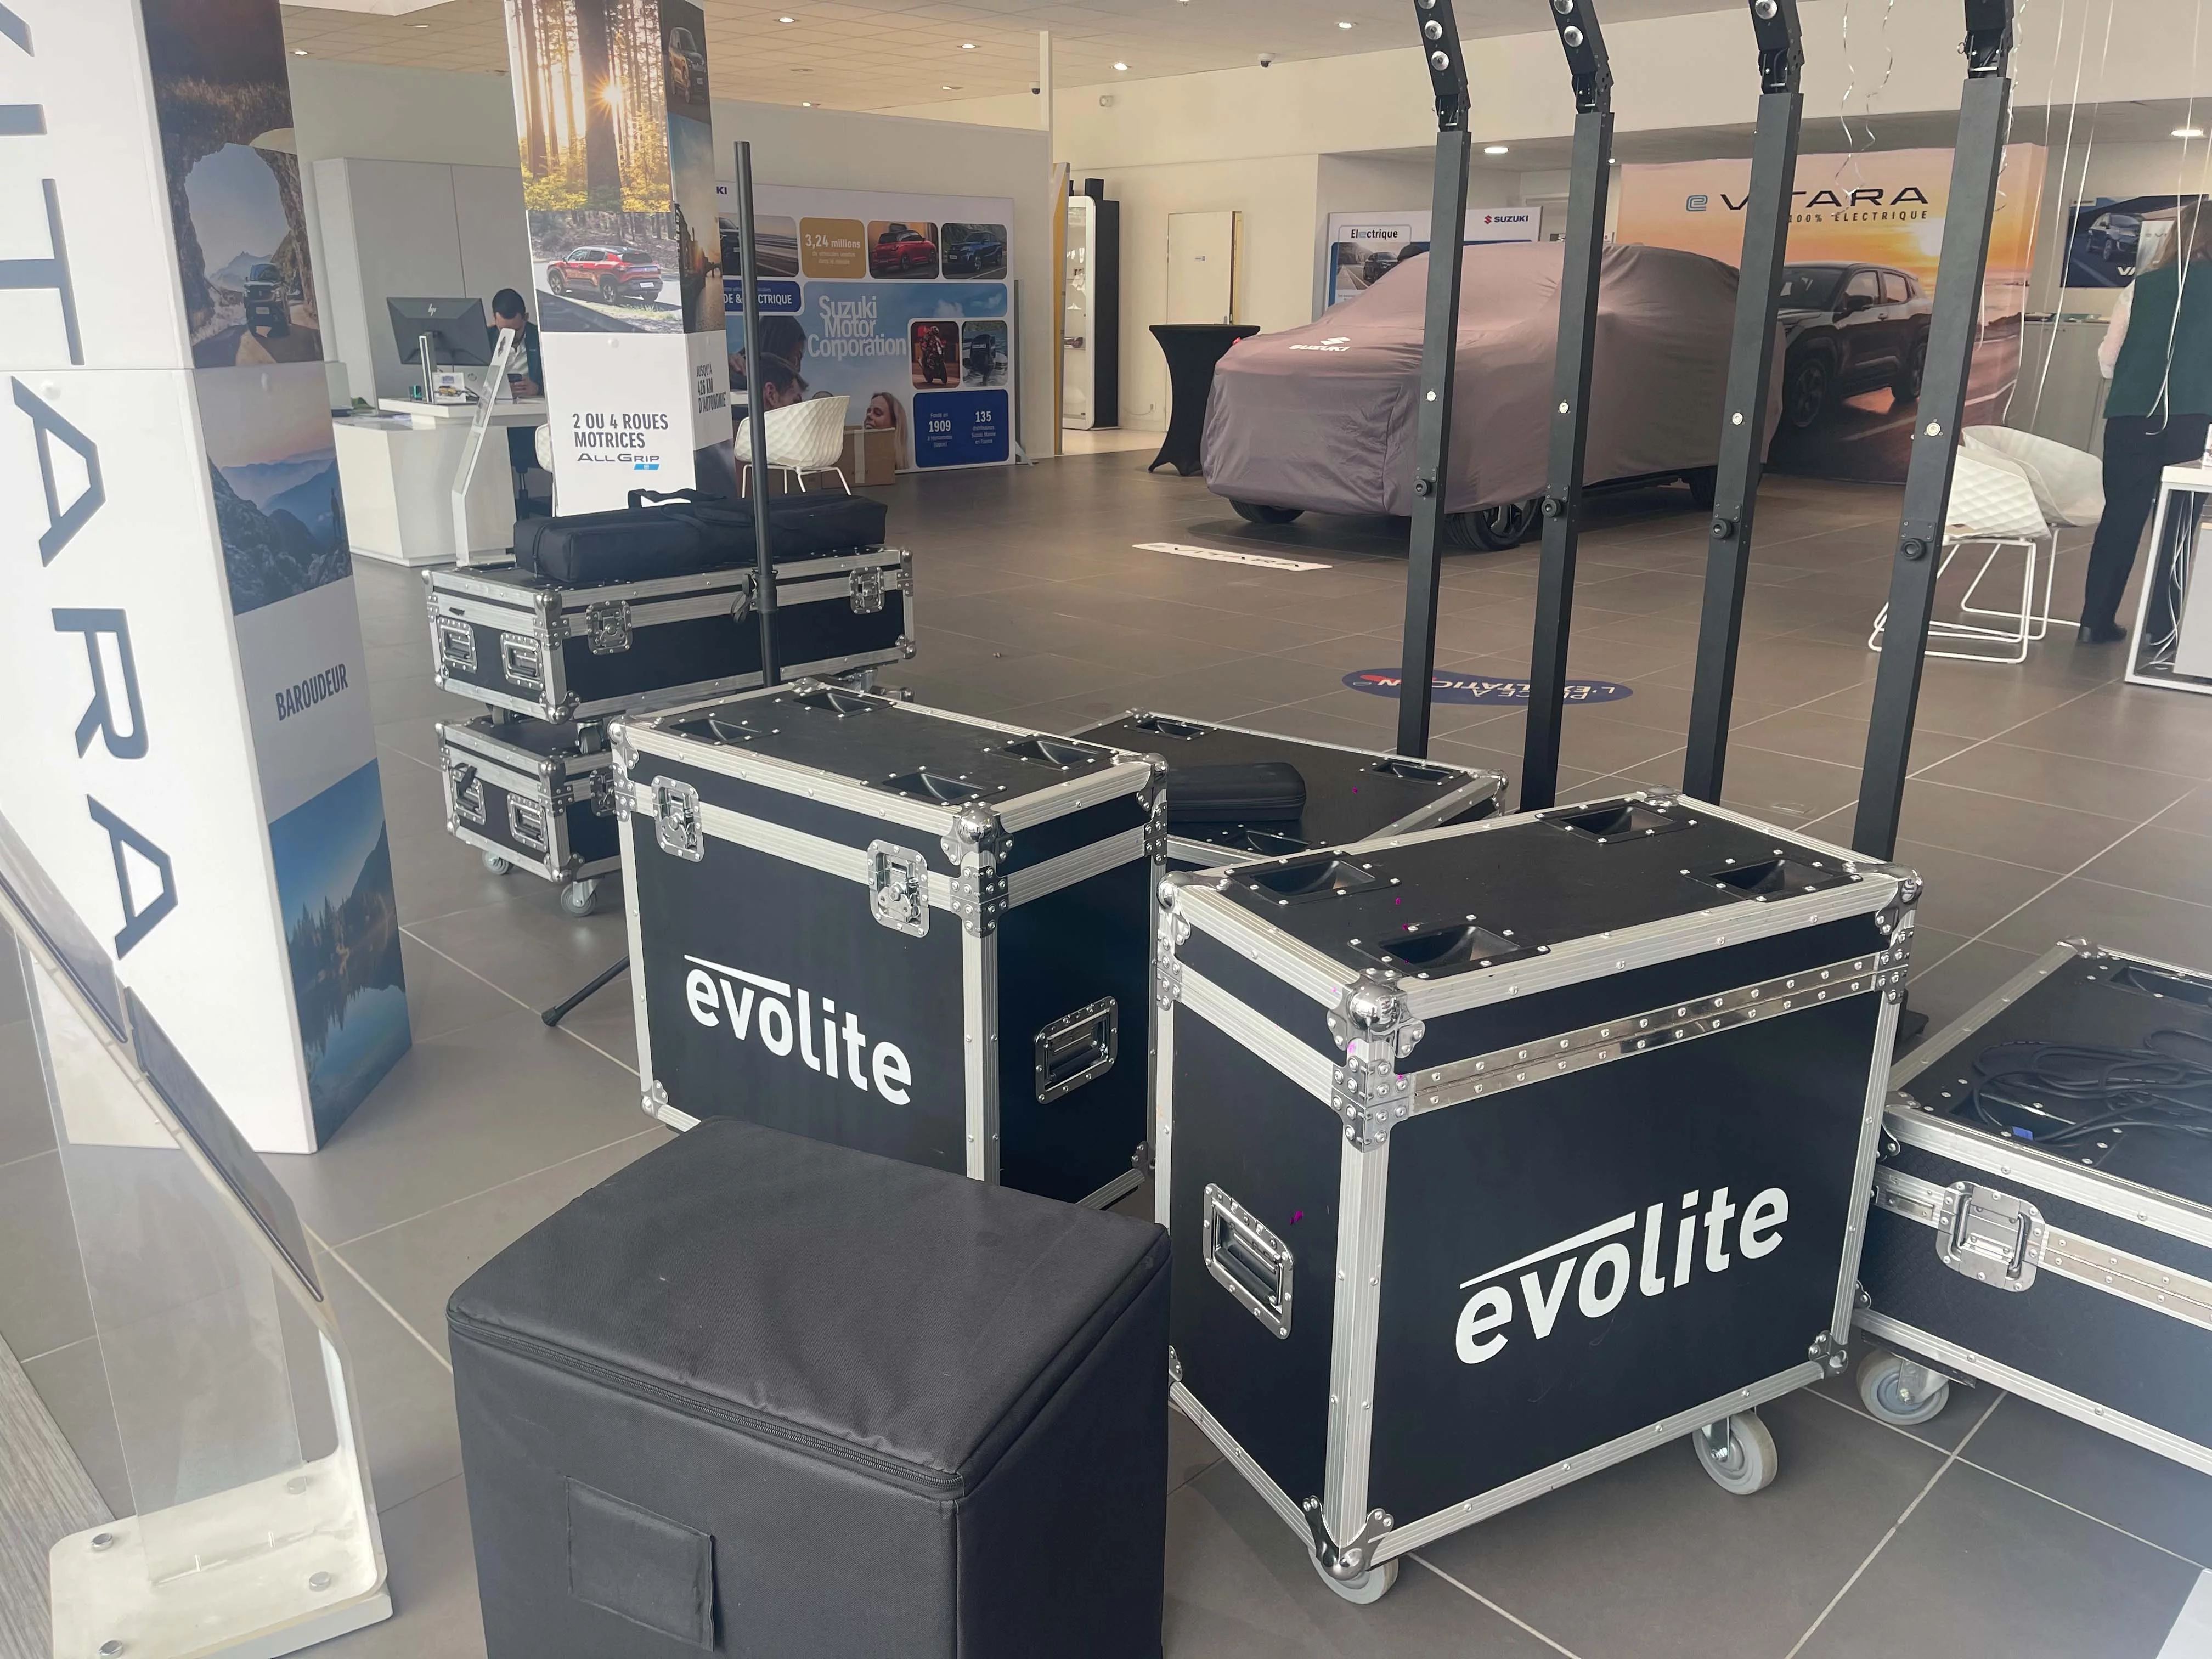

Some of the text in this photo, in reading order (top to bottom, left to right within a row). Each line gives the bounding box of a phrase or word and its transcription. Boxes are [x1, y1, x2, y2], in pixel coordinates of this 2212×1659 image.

[1494, 215, 1529, 223] SUZUKI
[805, 234, 861, 249] 3,24 millions
[758, 294, 792, 304] CTRIQUE
[818, 295, 877, 319] Suzuki
[823, 315, 877, 338] Motor
[807, 333, 906, 362] Corporation
[706, 377, 713, 394] KM
[572, 413, 669, 430] 2 OU 4 ROUES
[975, 411, 992, 422] 135
[929, 420, 951, 433] 1909
[574, 432, 646, 448] MOTRICES
[275, 663, 348, 721] BAROUDEUR
[686, 968, 912, 1105] evolite
[1455, 1187, 1789, 1365] evolite
